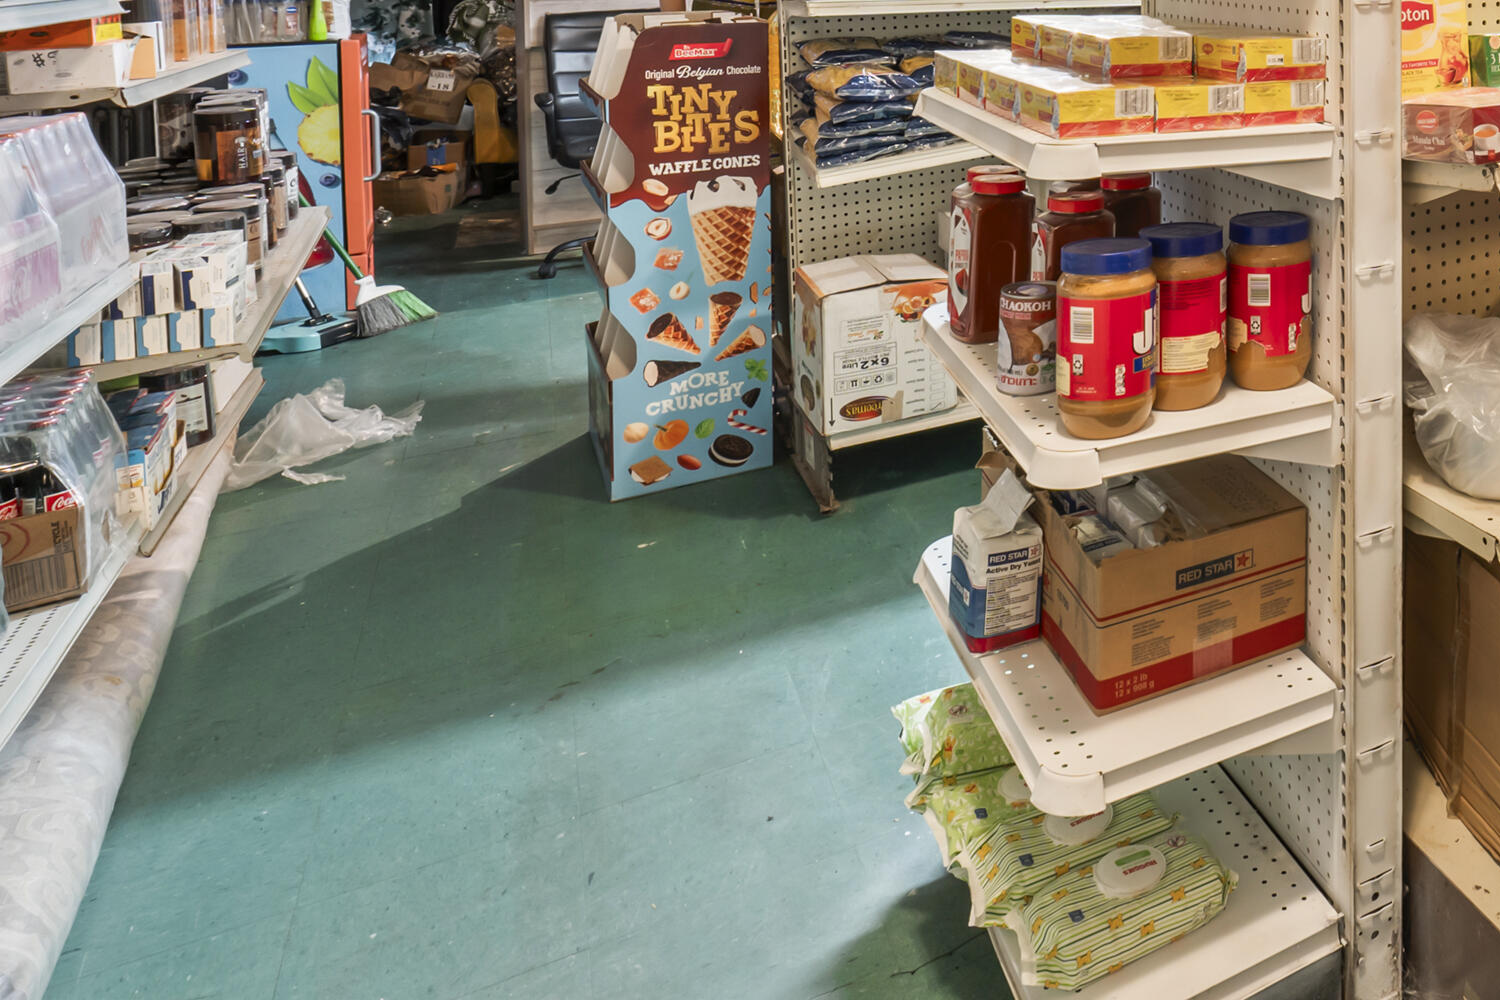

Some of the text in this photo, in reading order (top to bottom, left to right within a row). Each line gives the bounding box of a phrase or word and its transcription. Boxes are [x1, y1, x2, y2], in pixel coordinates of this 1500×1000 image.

[1490, 53, 1496, 65] 3
[645, 65, 761, 81] Original Belgian Chocolate
[647, 83, 738, 121] TINY
[653, 110, 760, 154] BITES
[649, 154, 760, 176] WAFFLE CONES
[670, 370, 730, 396] MORE
[645, 381, 745, 416] CRUNCHY
[989, 549, 1028, 564] RED STAR
[986, 566, 1008, 574] Active
[1010, 562, 1022, 571] Dry
[1178, 560, 1233, 584] RED STAR
[1114, 680, 1123, 689] 12
[1140, 673, 1148, 681] lb
[1133, 682, 1148, 692] 908
[1149, 680, 1155, 689] g
[1122, 859, 1157, 876] HUGGIES
